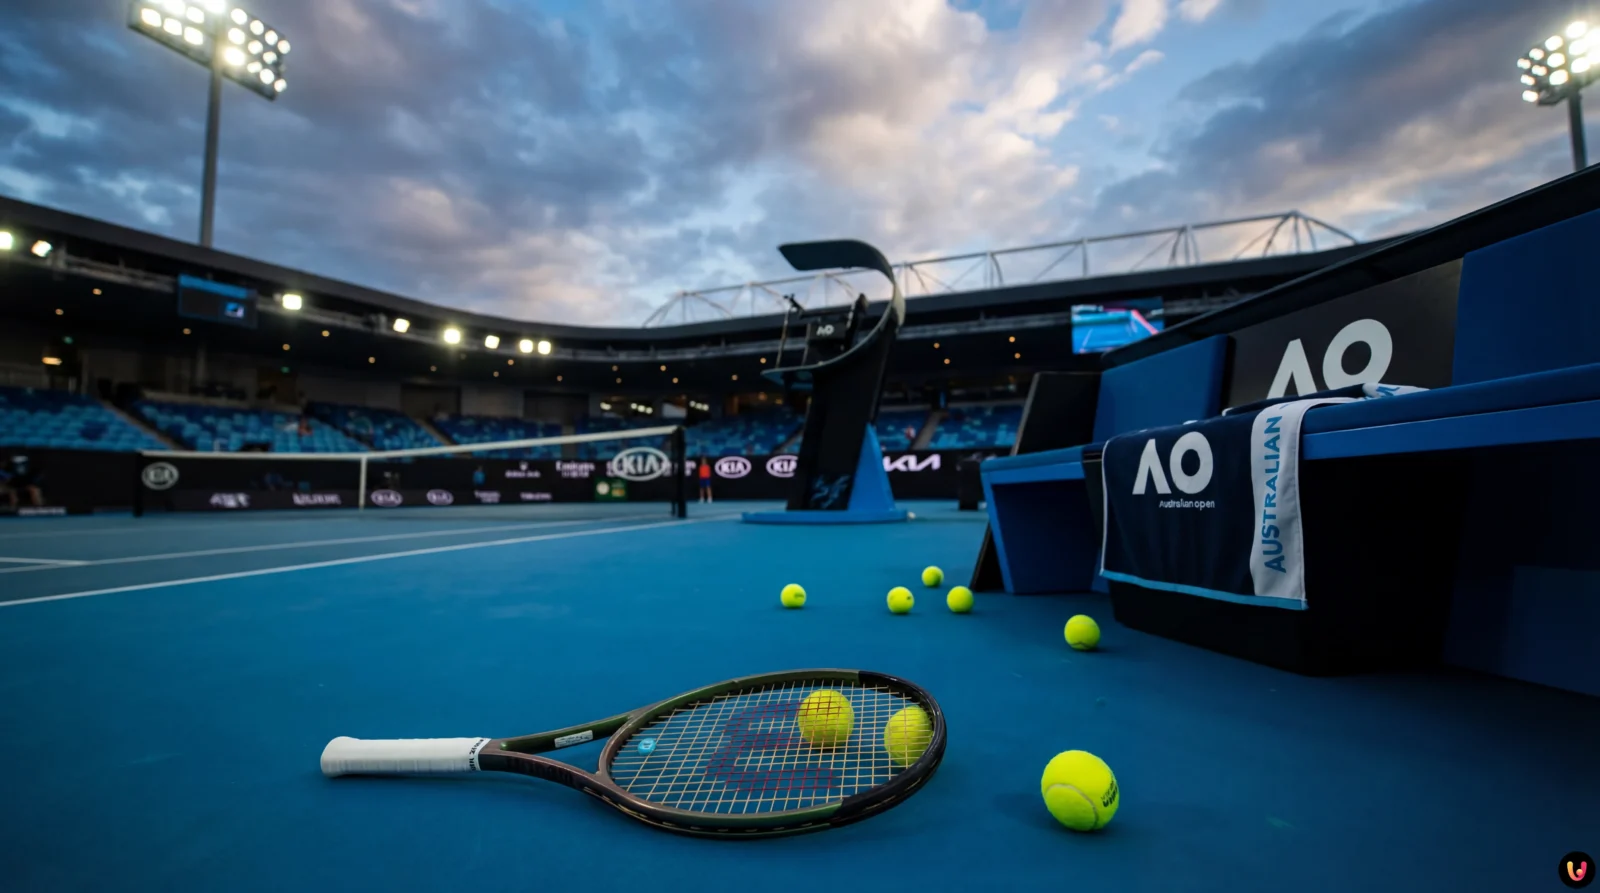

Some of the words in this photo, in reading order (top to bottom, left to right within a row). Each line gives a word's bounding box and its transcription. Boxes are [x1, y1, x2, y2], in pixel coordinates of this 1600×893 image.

[1266, 319, 1393, 401] AO
[622, 454, 660, 475] KIA
[718, 460, 746, 474] KIA
[1132, 431, 1214, 495] AO
[1194, 500, 1216, 511] open
[1261, 415, 1287, 574] AUSTRALIAN
